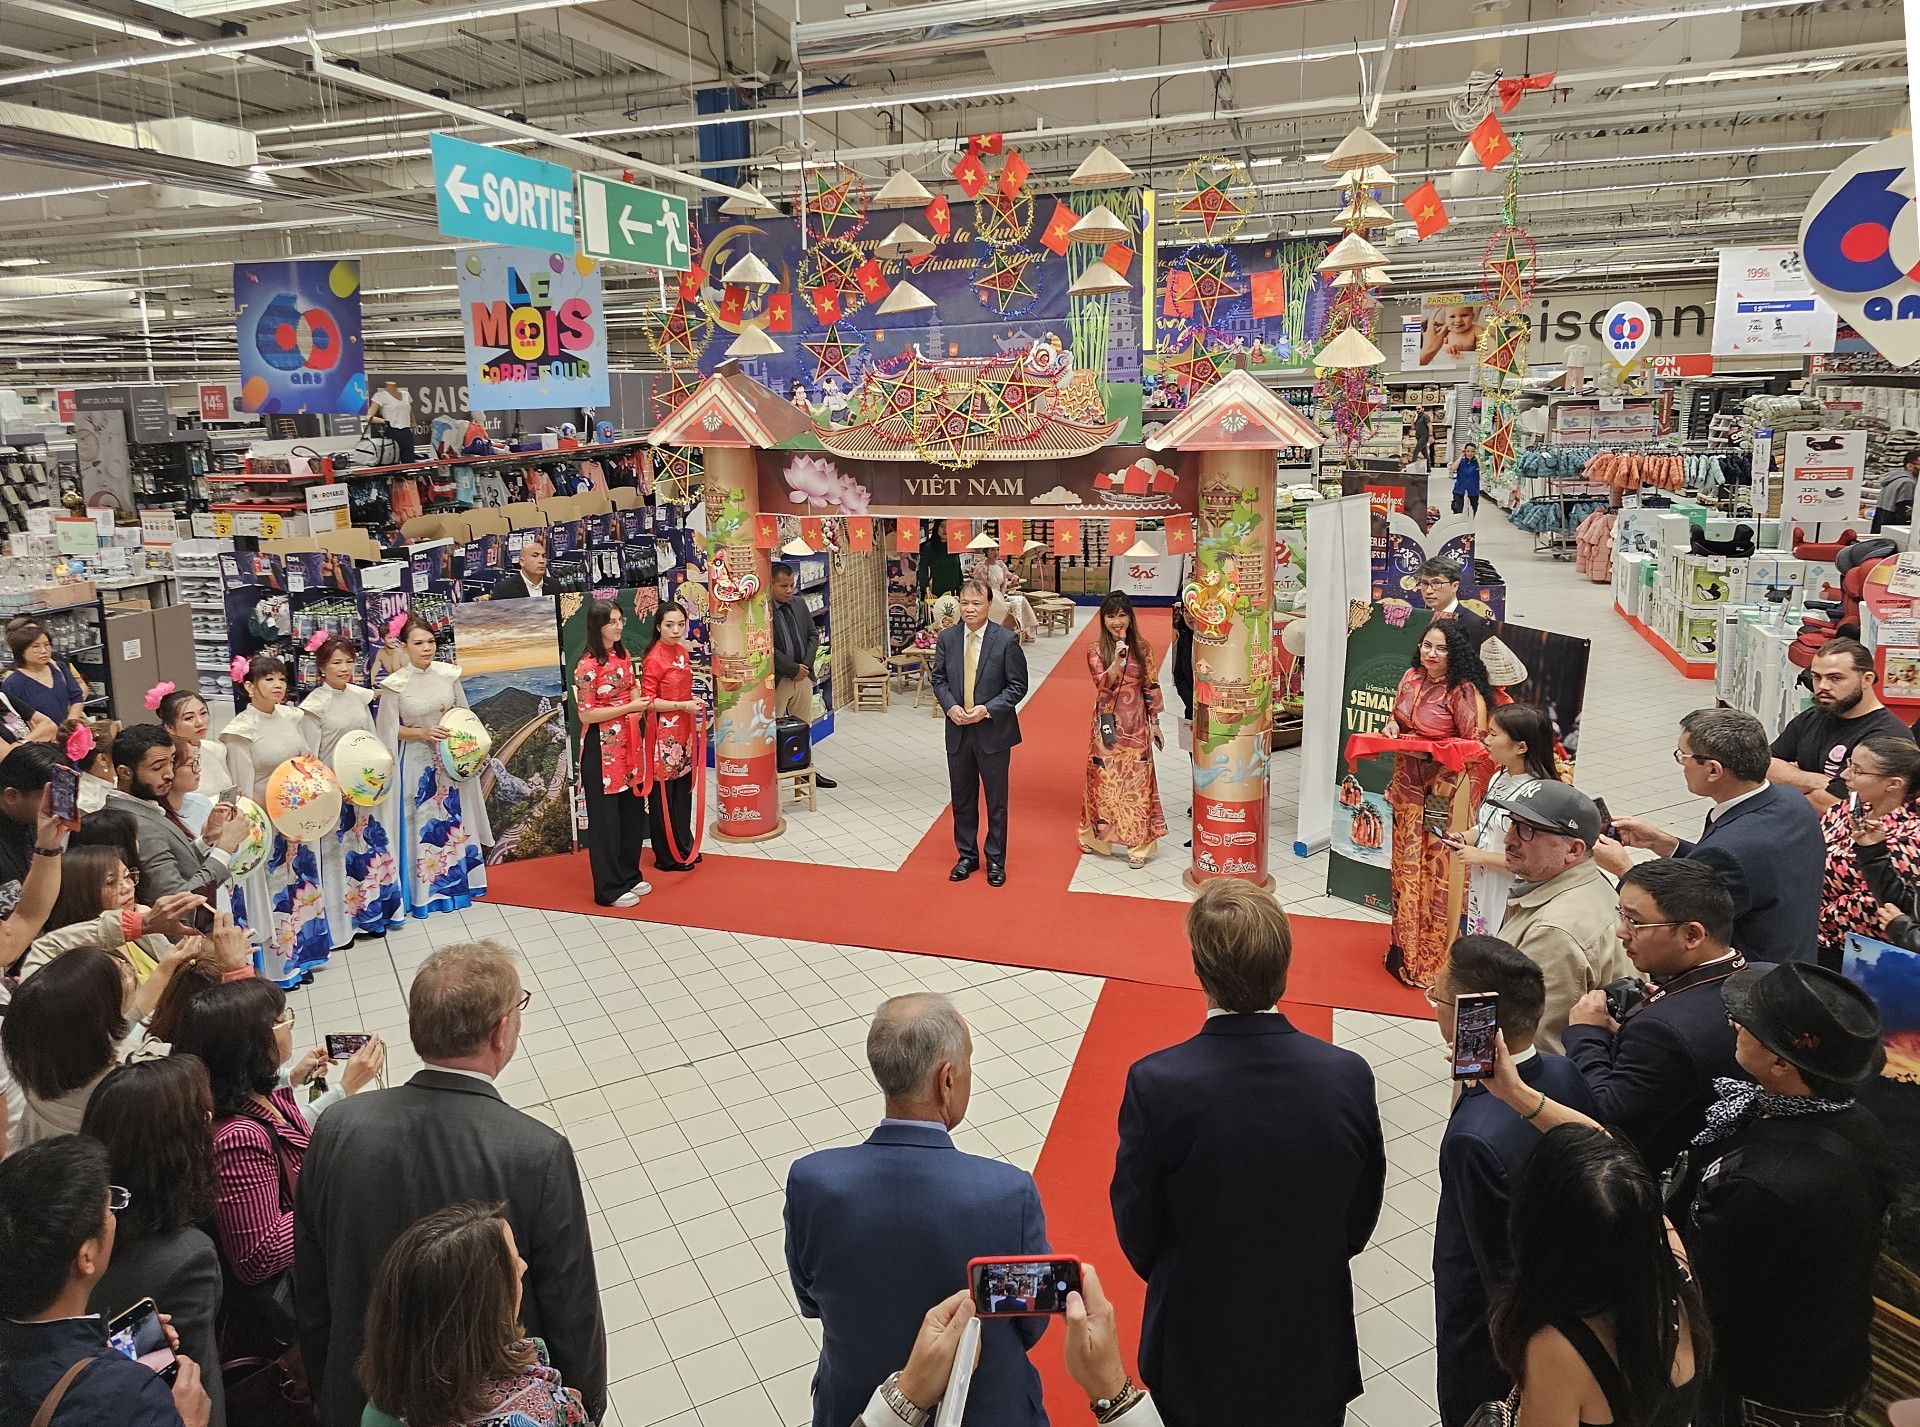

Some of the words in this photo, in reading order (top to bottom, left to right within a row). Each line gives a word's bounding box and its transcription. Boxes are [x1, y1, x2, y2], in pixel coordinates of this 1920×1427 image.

[482, 172, 574, 235] SORTIE
[1803, 167, 1920, 293] 6
[507, 266, 552, 307] LE
[1427, 294, 1462, 304] PARENTS
[1863, 295, 1920, 322] an
[255, 292, 341, 371] 60
[1608, 313, 1644, 341] 60
[1613, 340, 1637, 349] ans
[290, 372, 323, 385] ans
[479, 360, 592, 385] CARREFOUR
[109, 396, 125, 404] TABLE
[419, 386, 470, 415] SAIS
[903, 474, 961, 496] VIÊT
[967, 478, 1024, 496] NAM
[414, 553, 427, 561] DIM
[381, 592, 408, 620] DIM
[1350, 689, 1395, 712] SEMAI
[1346, 706, 1389, 734] VIET
